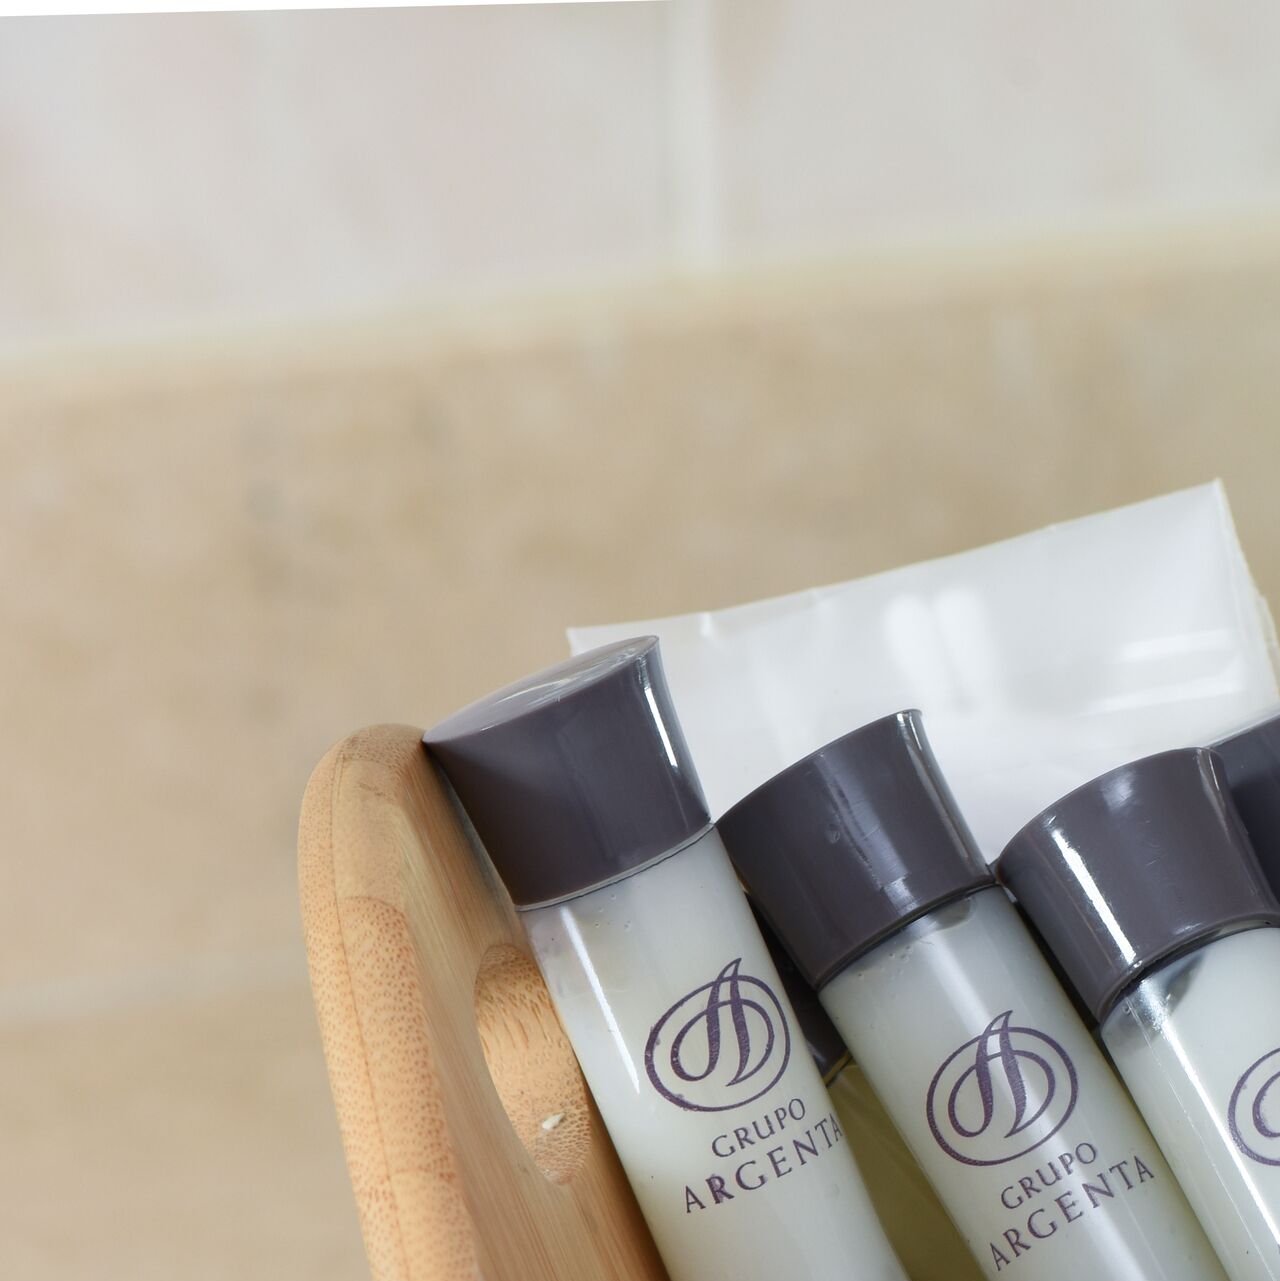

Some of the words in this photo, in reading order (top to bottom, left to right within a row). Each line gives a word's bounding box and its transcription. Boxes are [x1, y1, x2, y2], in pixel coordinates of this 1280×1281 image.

[684, 1113, 844, 1214] ARGENTA
[711, 1098, 806, 1158] GRUPO
[988, 1155, 1156, 1272] ARGENTA
[1000, 1142, 1098, 1210] GRUPO
